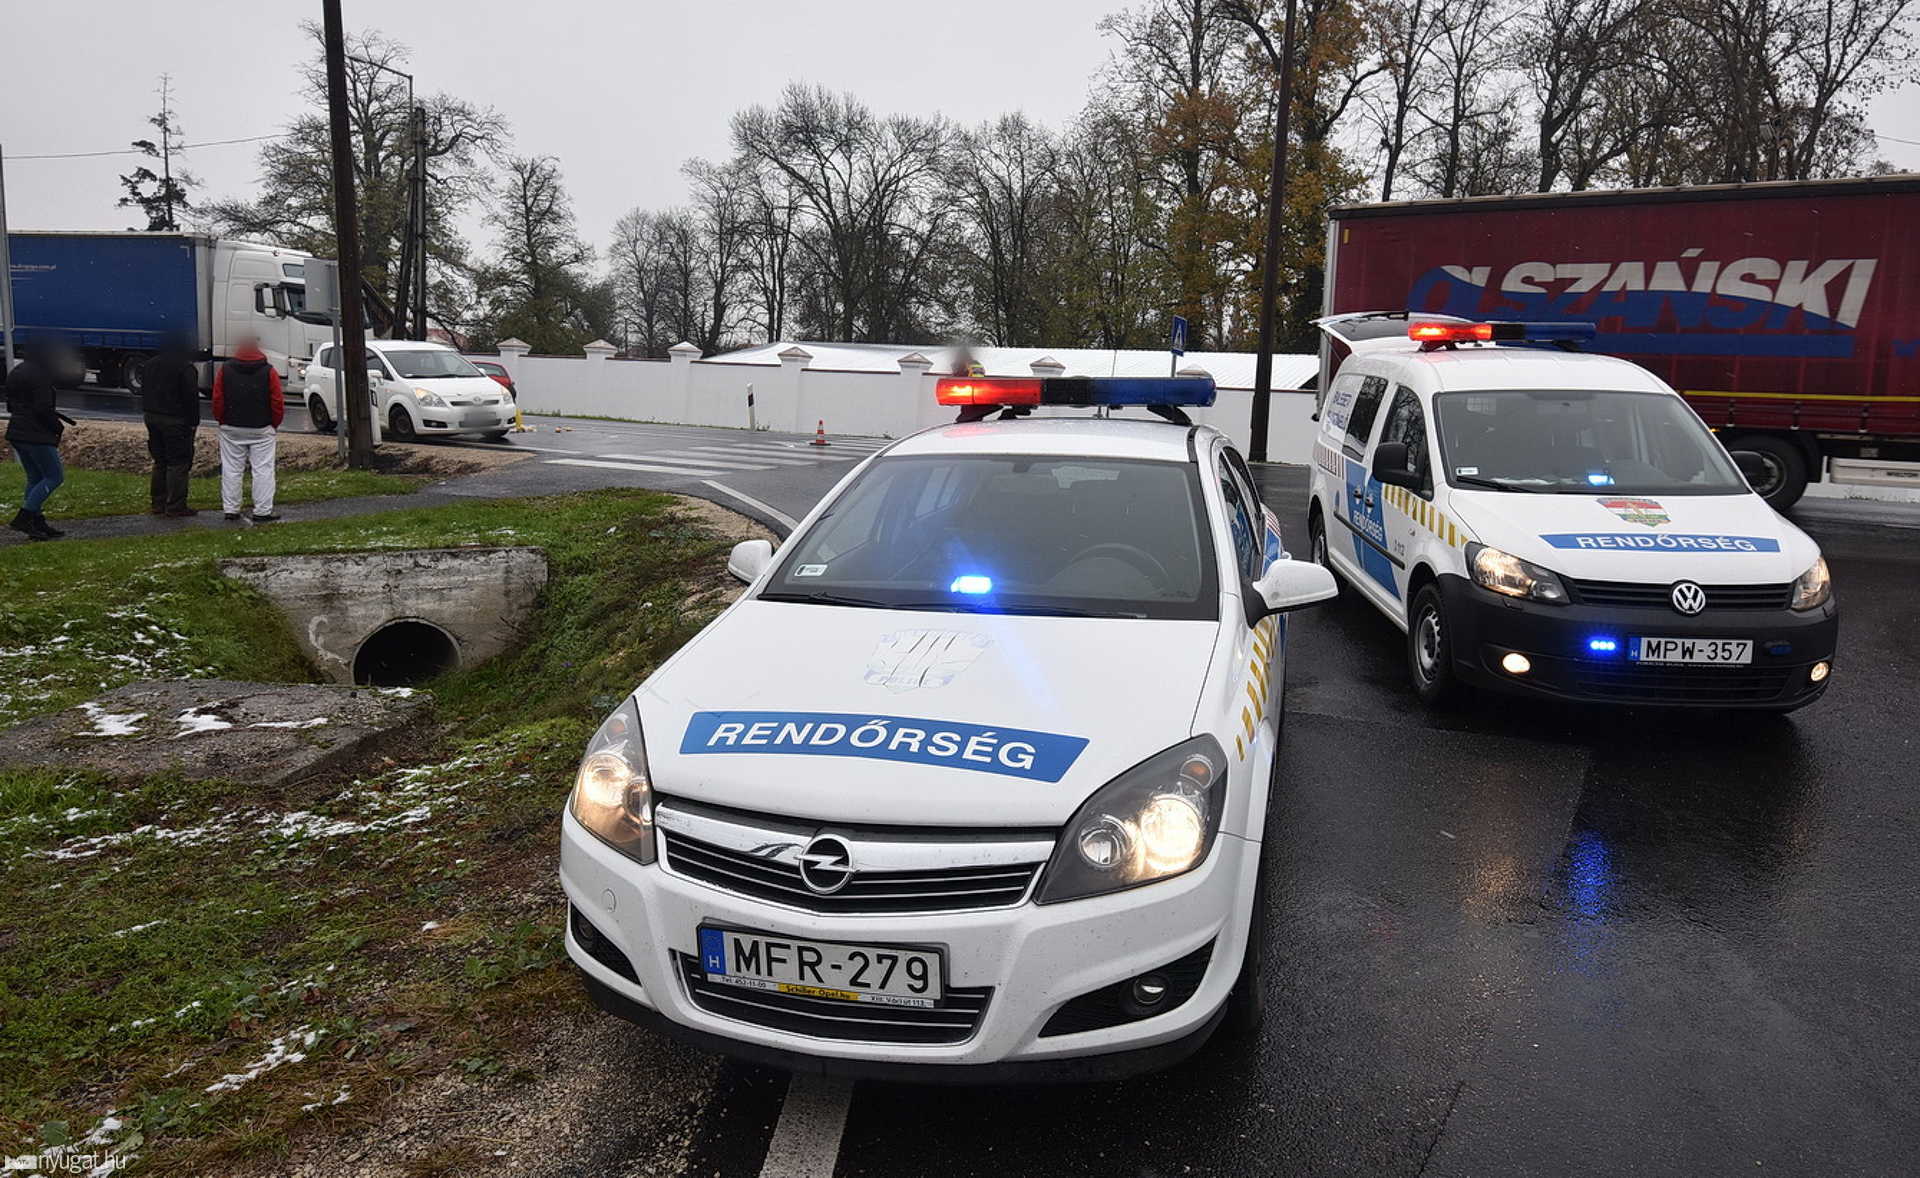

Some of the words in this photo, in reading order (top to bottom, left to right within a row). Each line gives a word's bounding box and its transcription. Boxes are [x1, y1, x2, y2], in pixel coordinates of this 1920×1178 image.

[1406, 248, 1879, 329] OLSZAŃSKI
[1576, 534, 1758, 552] RENDŐRSÉG
[1645, 640, 1748, 661] MPW-357
[706, 719, 1037, 771] RENDŐRSÉG
[709, 955, 720, 969] H
[733, 938, 930, 995] MFR-279
